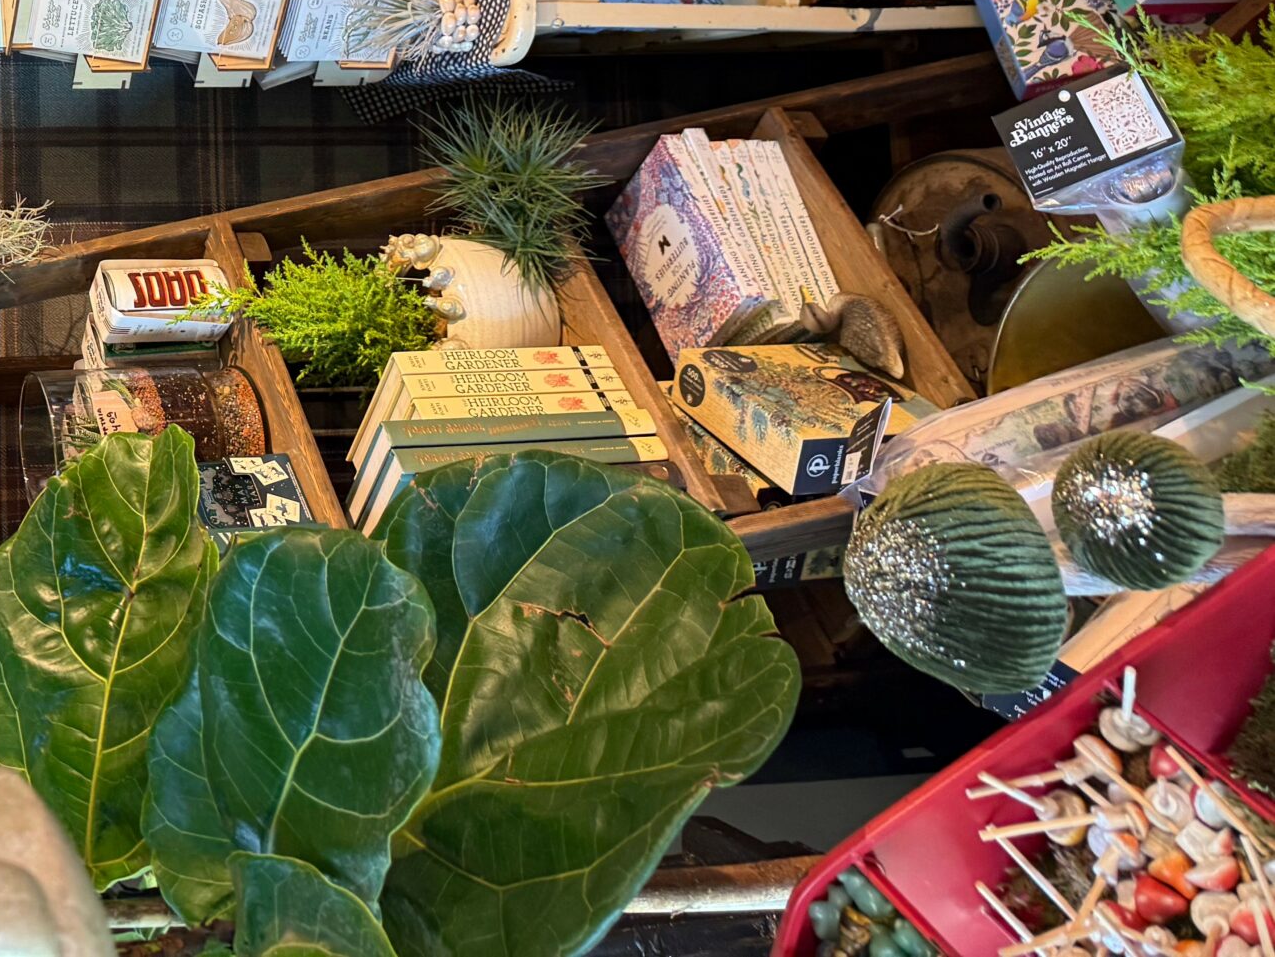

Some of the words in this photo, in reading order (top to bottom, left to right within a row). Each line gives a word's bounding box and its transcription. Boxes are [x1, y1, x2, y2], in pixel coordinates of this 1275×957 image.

[67, 0, 79, 36] LETTUCE
[323, 14, 335, 40] BEANS
[1009, 114, 1075, 148] Banners
[1014, 107, 1067, 130] Vintage
[1027, 170, 1047, 181] Printed
[1072, 152, 1091, 163] Canvas
[1054, 146, 1089, 162] Reproduction
[1043, 170, 1065, 182] Wooden
[1064, 161, 1087, 174] Magnetic
[1087, 154, 1107, 164] Hanger
[718, 184, 734, 206] BIRDS
[701, 194, 726, 236] BUTTERFLIES
[729, 207, 747, 238] GARDEN
[723, 236, 735, 250] FOR
[761, 210, 783, 255] HONEYBEES
[779, 214, 804, 268] WILDFLOWERS
[797, 214, 824, 268] WILDFLOWERS
[742, 239, 752, 252] FOR
[655, 236, 689, 282] BUTTERFLIES
[729, 250, 753, 287] PLANTING
[747, 252, 771, 291] PLANTING
[667, 260, 697, 298] PLANTING
[800, 270, 820, 306] ANTING
[821, 270, 837, 295] NTING
[407, 356, 417, 368] JOHN
[443, 348, 520, 360] HEIRLOOM
[445, 358, 523, 370] GARDENER
[417, 378, 426, 391] JOHN
[454, 372, 530, 384] HEIRLOOM
[455, 382, 533, 394] GARDENER
[430, 403, 439, 414] JOHN
[467, 396, 543, 407] HEIRLOOM
[468, 405, 547, 416] GARDENER
[831, 444, 845, 484] paperblanks
[235, 484, 247, 504] MAP
